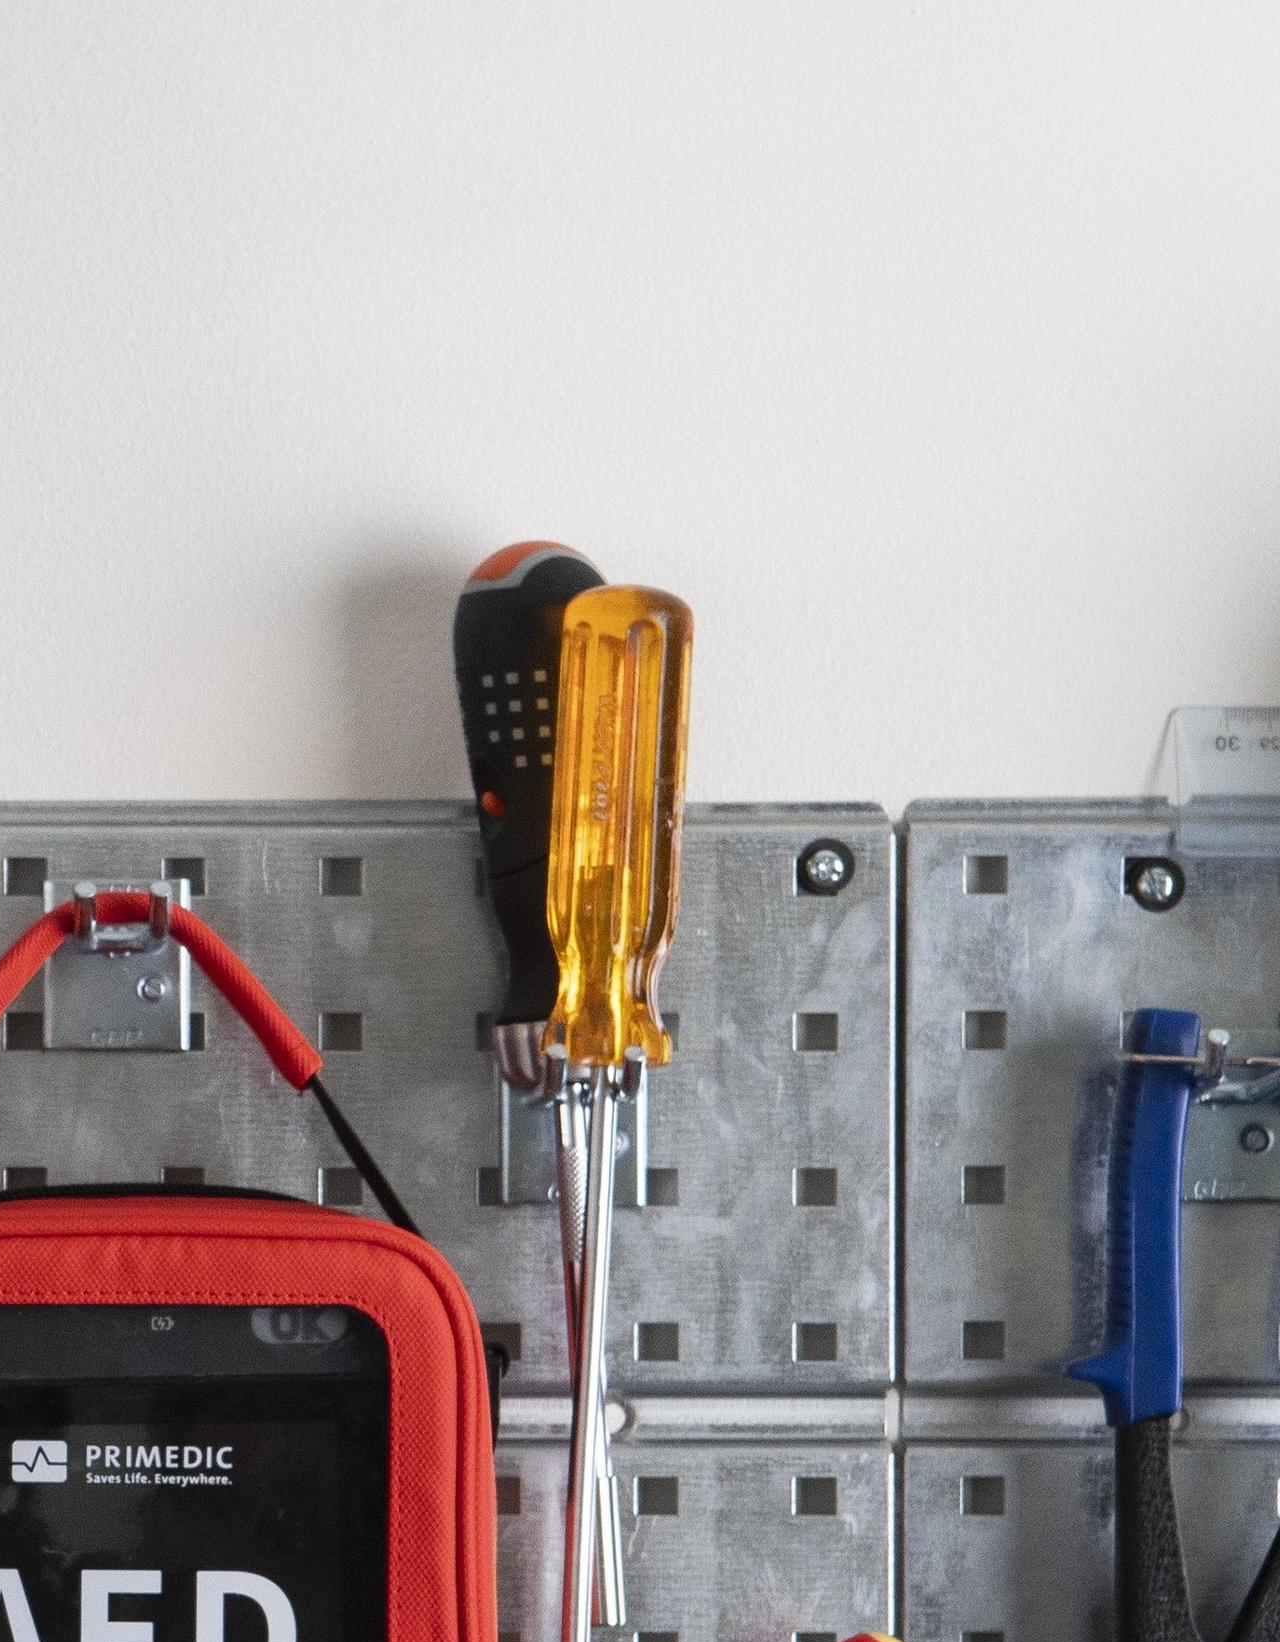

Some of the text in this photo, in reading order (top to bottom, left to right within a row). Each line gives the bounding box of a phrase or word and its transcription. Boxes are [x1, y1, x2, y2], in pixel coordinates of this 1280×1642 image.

[270, 1307, 331, 1341] OK
[86, 1445, 234, 1470] PRIMEDIC
[86, 1471, 233, 1488] Saves Life. Everywhere.
